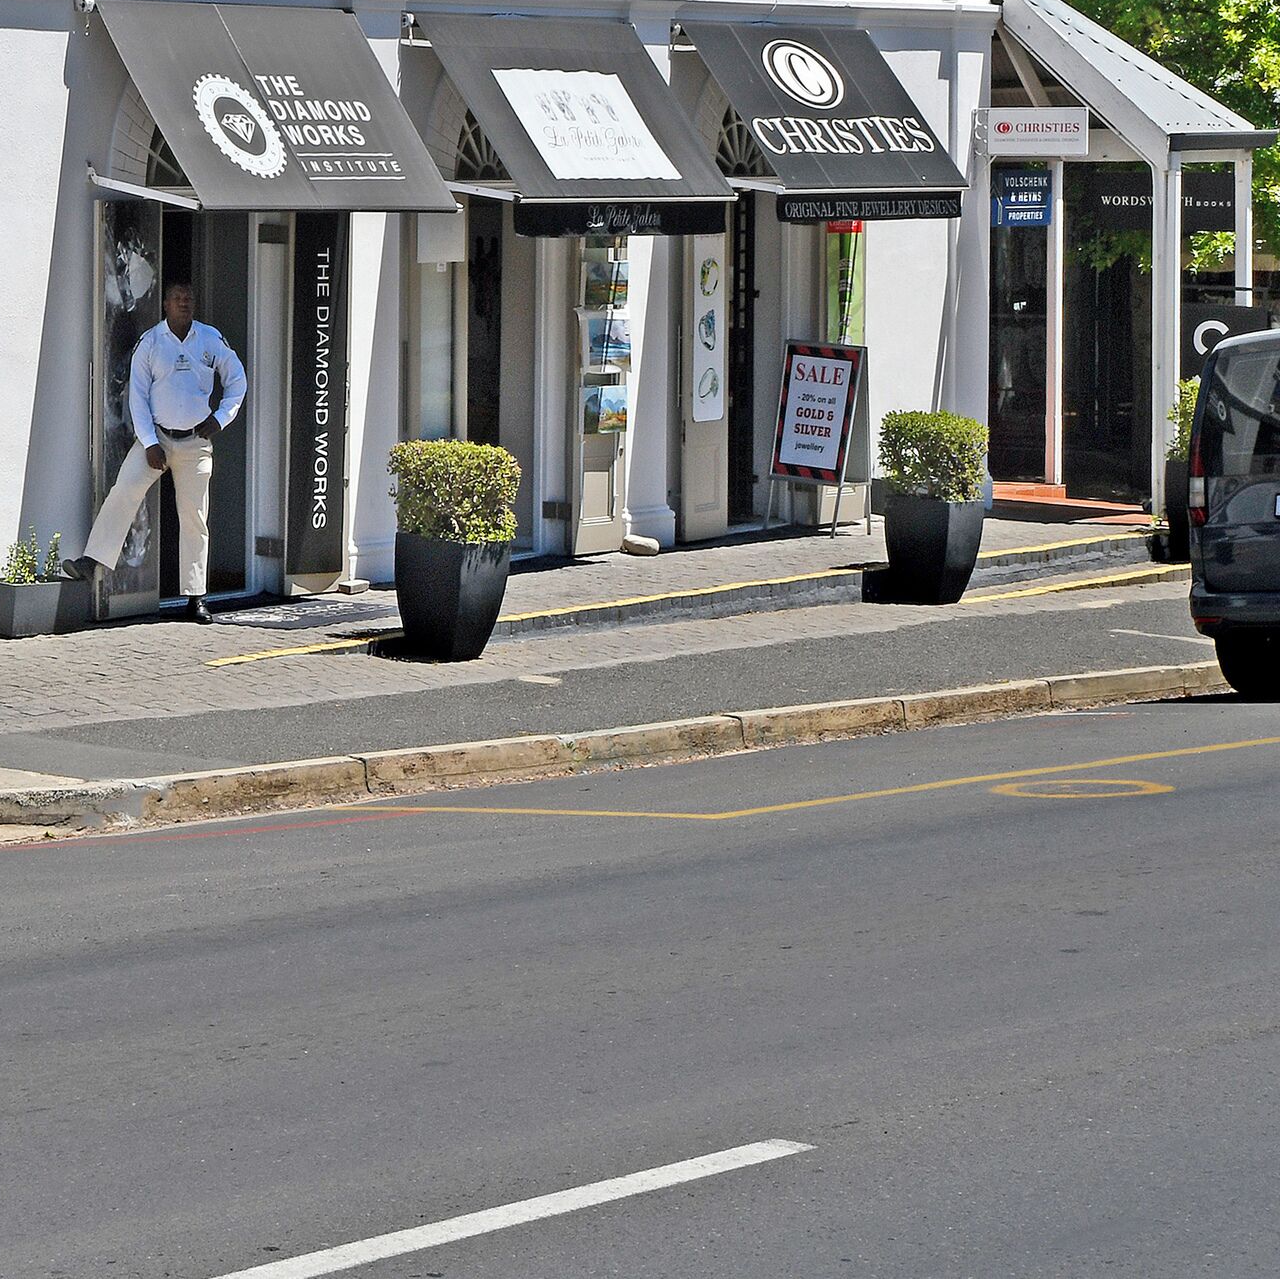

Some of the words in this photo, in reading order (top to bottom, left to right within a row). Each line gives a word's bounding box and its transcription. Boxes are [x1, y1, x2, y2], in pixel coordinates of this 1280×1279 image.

[255, 75, 304, 96] THE
[268, 100, 372, 121] DIAMOND
[281, 124, 366, 146] WORKS
[751, 116, 936, 155] CHRISTIES
[1015, 122, 1080, 133] CHRISTIES
[301, 160, 402, 172] INSTITUTE
[1004, 176, 1048, 187] VOLSCHENK
[587, 205, 605, 228] La
[785, 201, 835, 218] ORIGINAL
[836, 201, 859, 218] FINE
[859, 200, 917, 217] JEWELLERY
[917, 199, 958, 215] DESIGNS
[1008, 211, 1043, 220] PROPERTIES
[316, 247, 330, 297] THE
[314, 306, 330, 426] DIAMOND
[795, 362, 845, 386] SALE
[796, 406, 825, 420] GOLD
[826, 410, 834, 421] &
[794, 423, 831, 438] SILVER
[312, 432, 329, 529] WORKS
